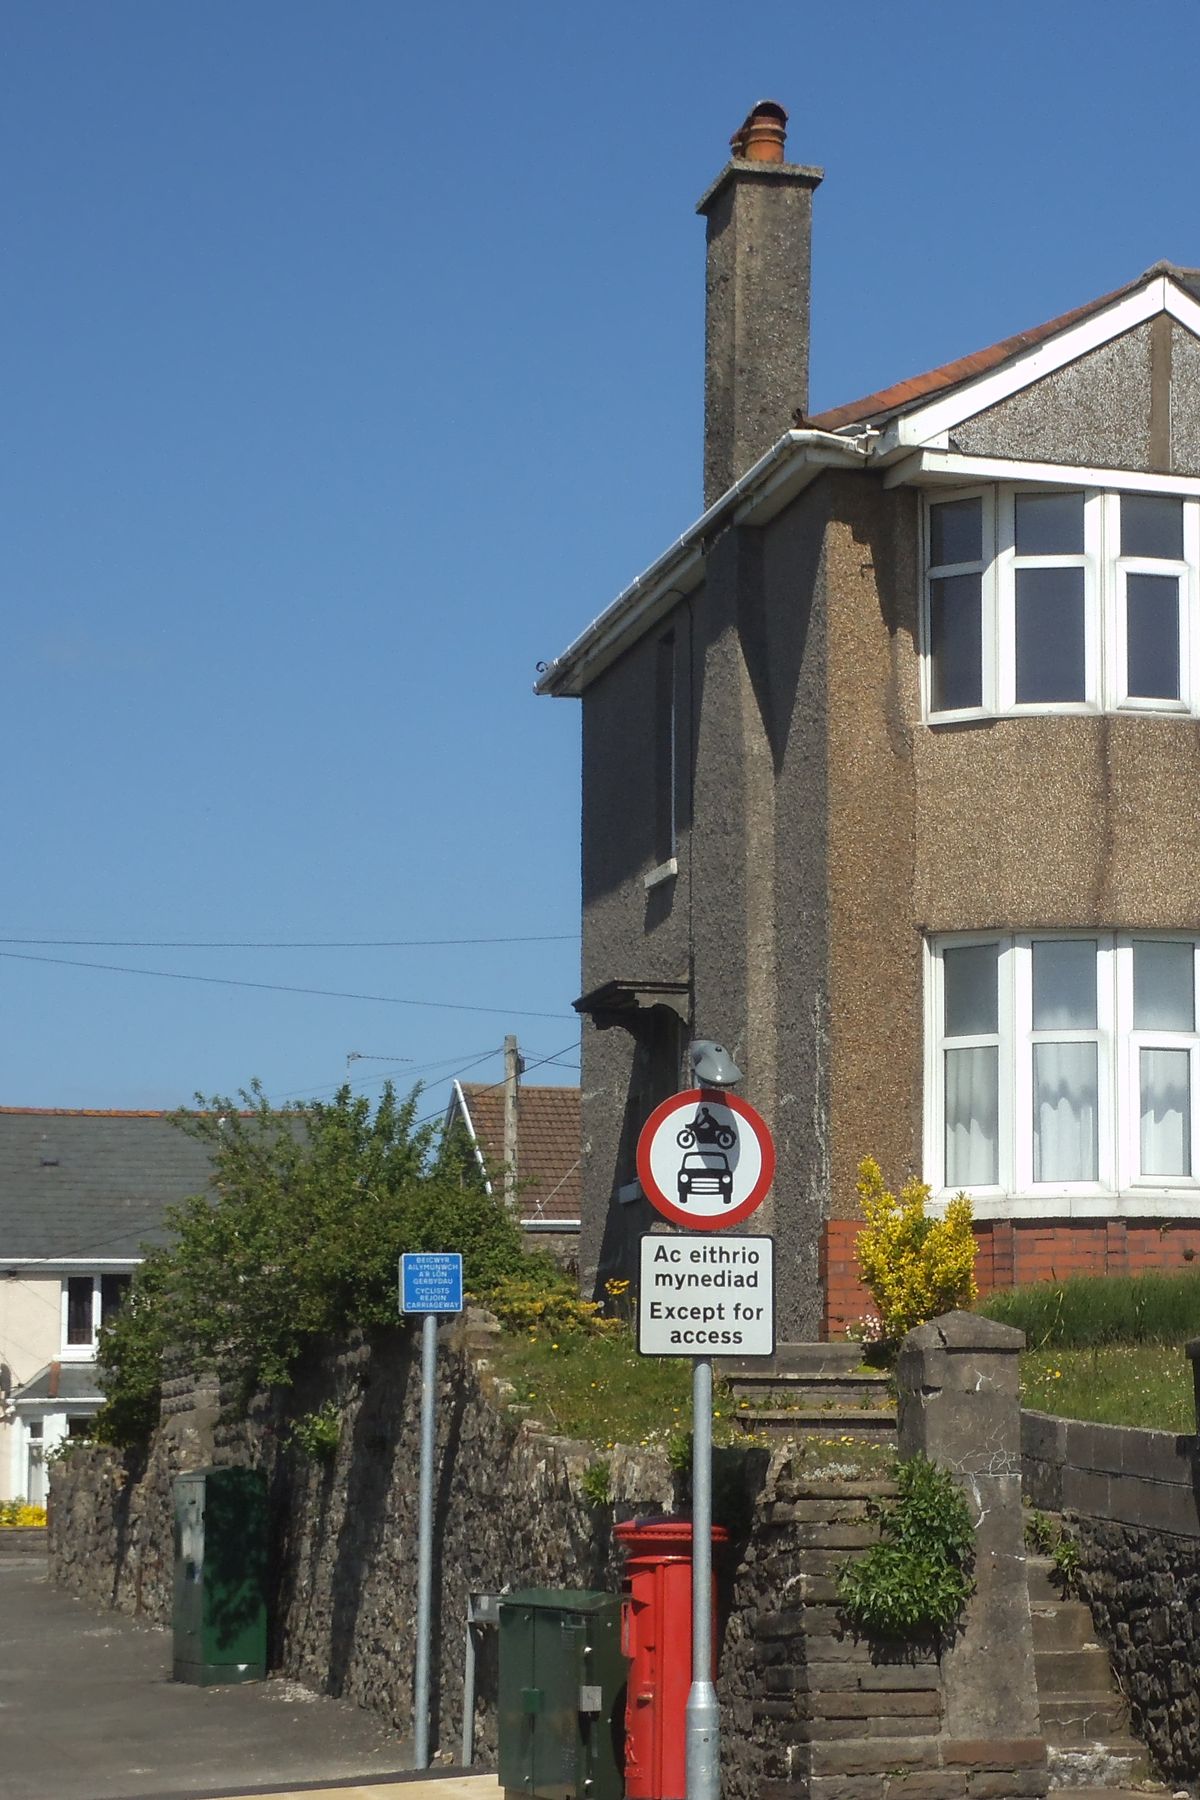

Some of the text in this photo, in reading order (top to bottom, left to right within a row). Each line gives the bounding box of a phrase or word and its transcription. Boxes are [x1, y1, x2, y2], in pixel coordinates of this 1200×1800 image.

[654, 1245, 760, 1264] Ac eithrio
[655, 1269, 759, 1290] mynediad
[649, 1301, 764, 1323] Except for
[671, 1330, 743, 1344] access
